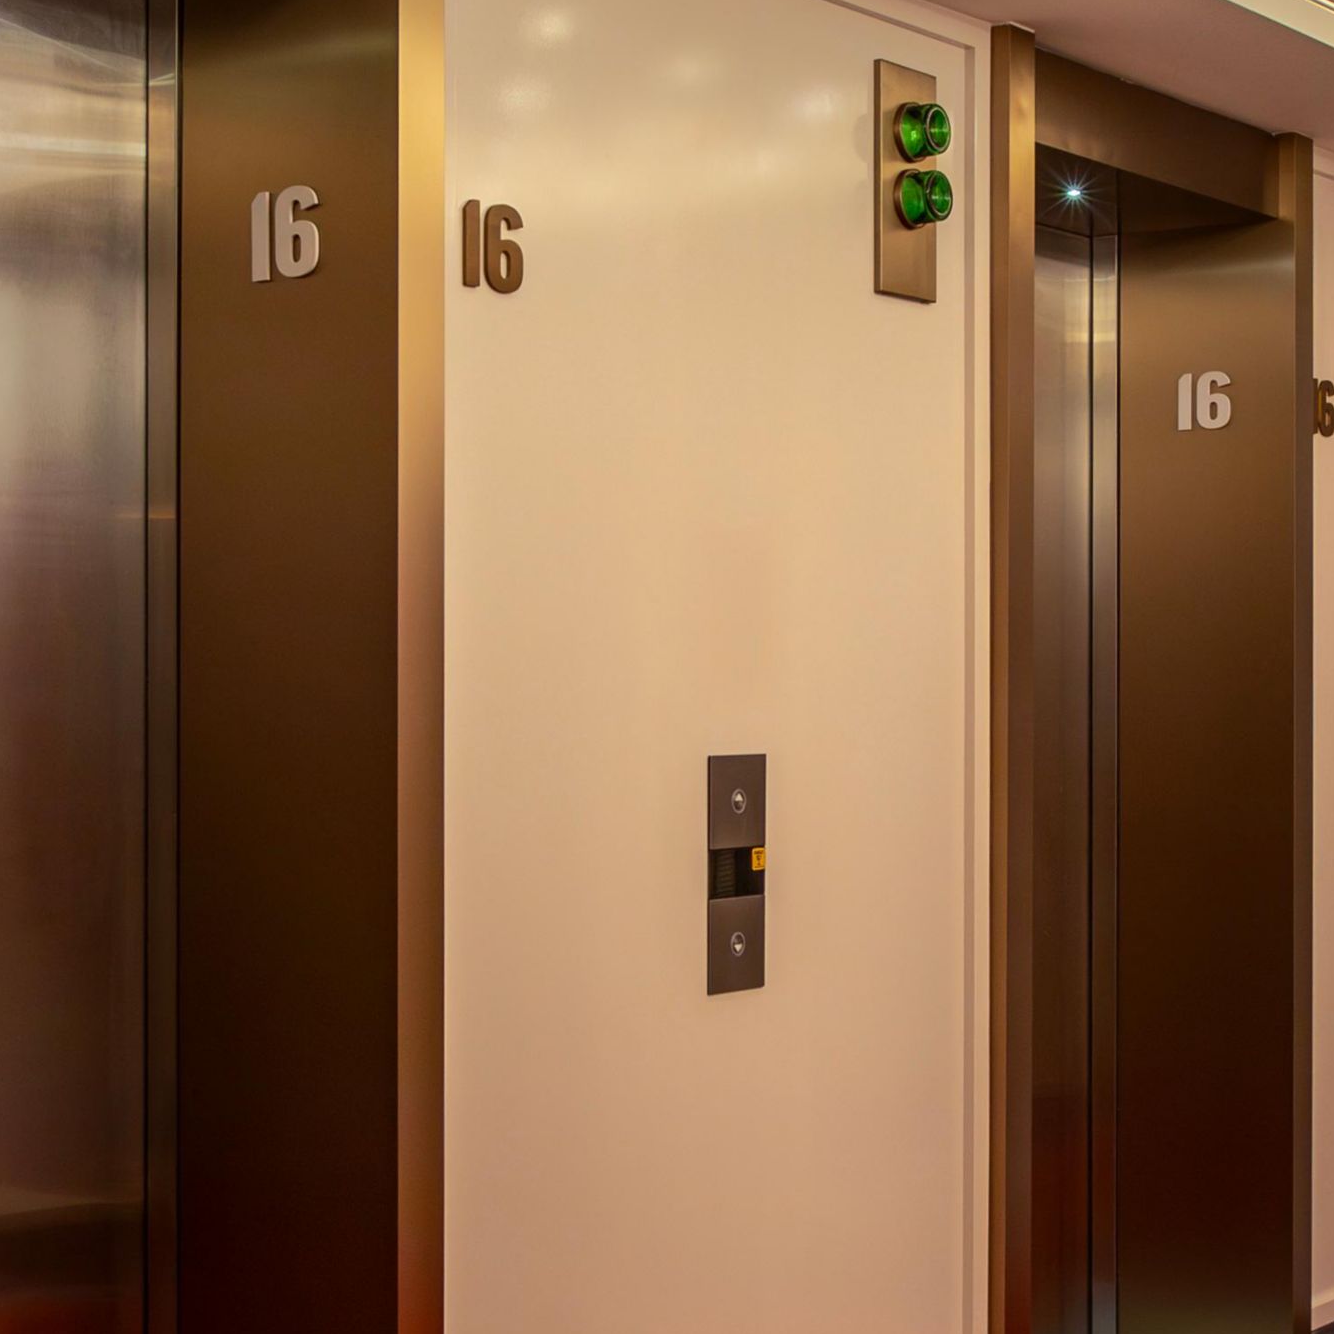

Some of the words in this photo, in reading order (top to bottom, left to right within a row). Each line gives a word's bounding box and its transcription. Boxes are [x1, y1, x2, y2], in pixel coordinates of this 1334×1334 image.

[251, 185, 319, 282] 16
[462, 199, 524, 294] 16
[1177, 371, 1231, 431] 16
